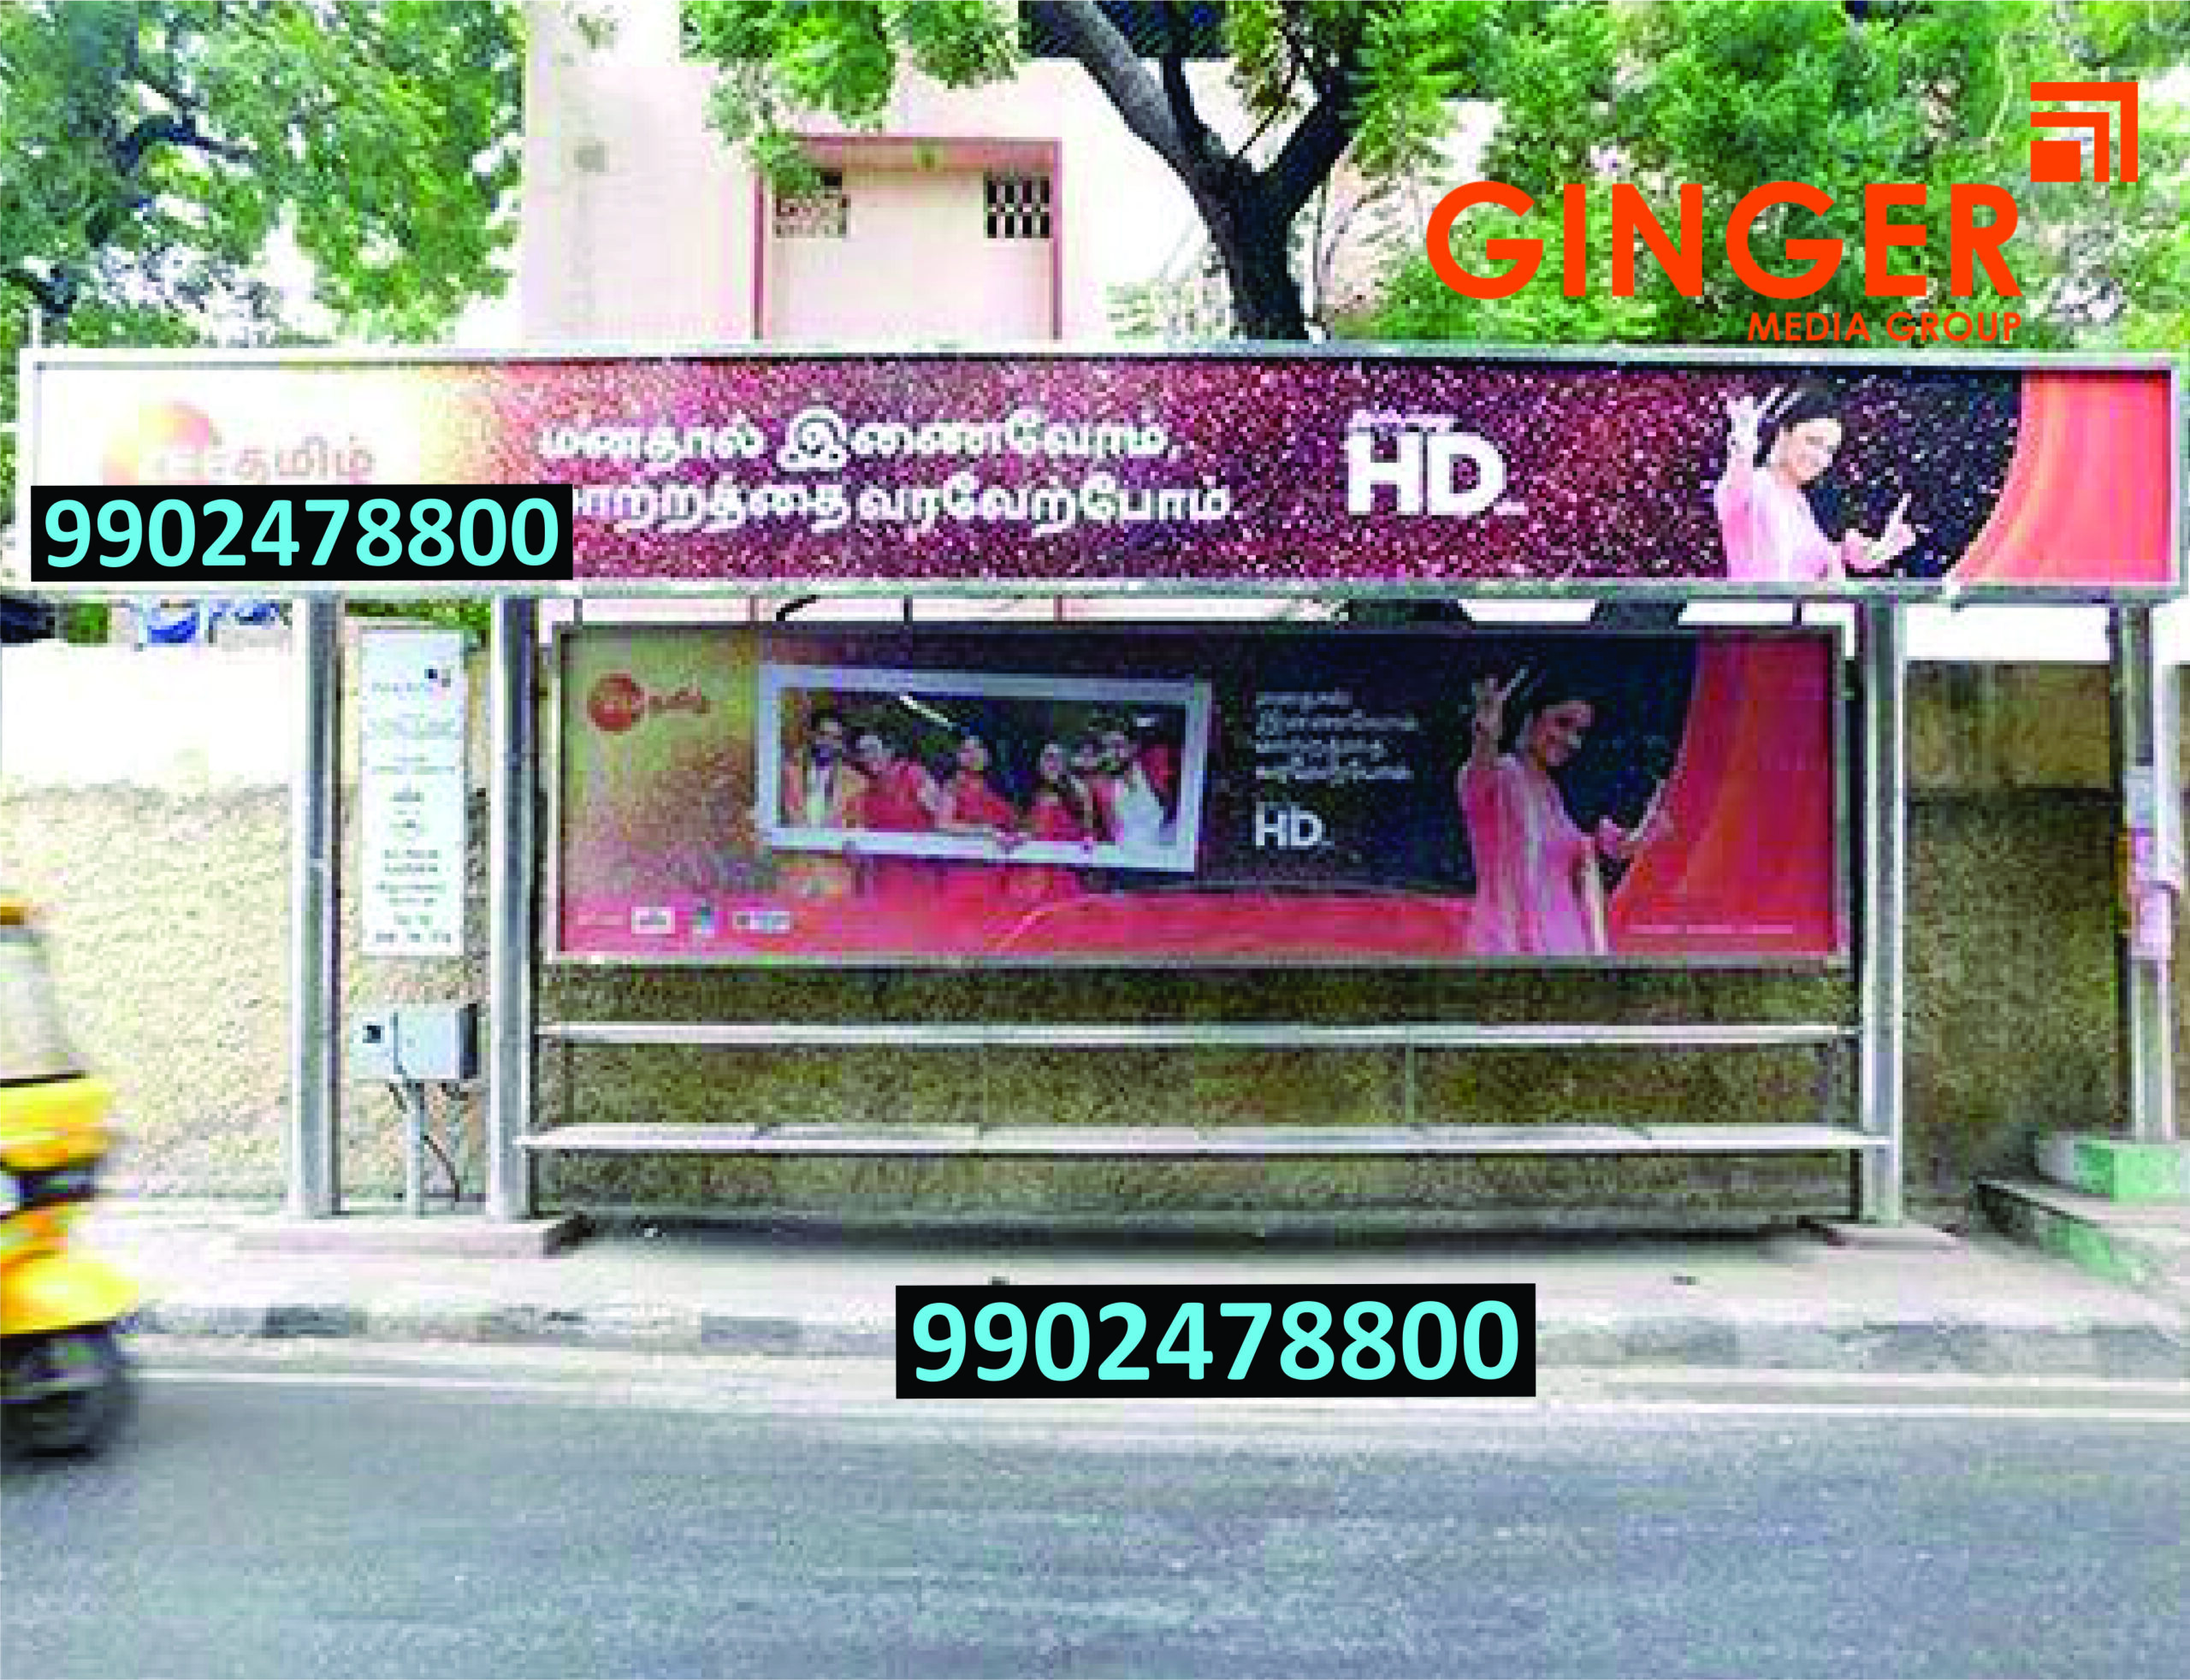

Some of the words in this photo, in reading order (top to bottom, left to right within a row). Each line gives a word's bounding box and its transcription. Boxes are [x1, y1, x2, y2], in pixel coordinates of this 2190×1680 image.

[1347, 431, 1506, 515] HD
[573, 476, 850, 534] ாற்றத்தை
[1256, 806, 1323, 846] HD
